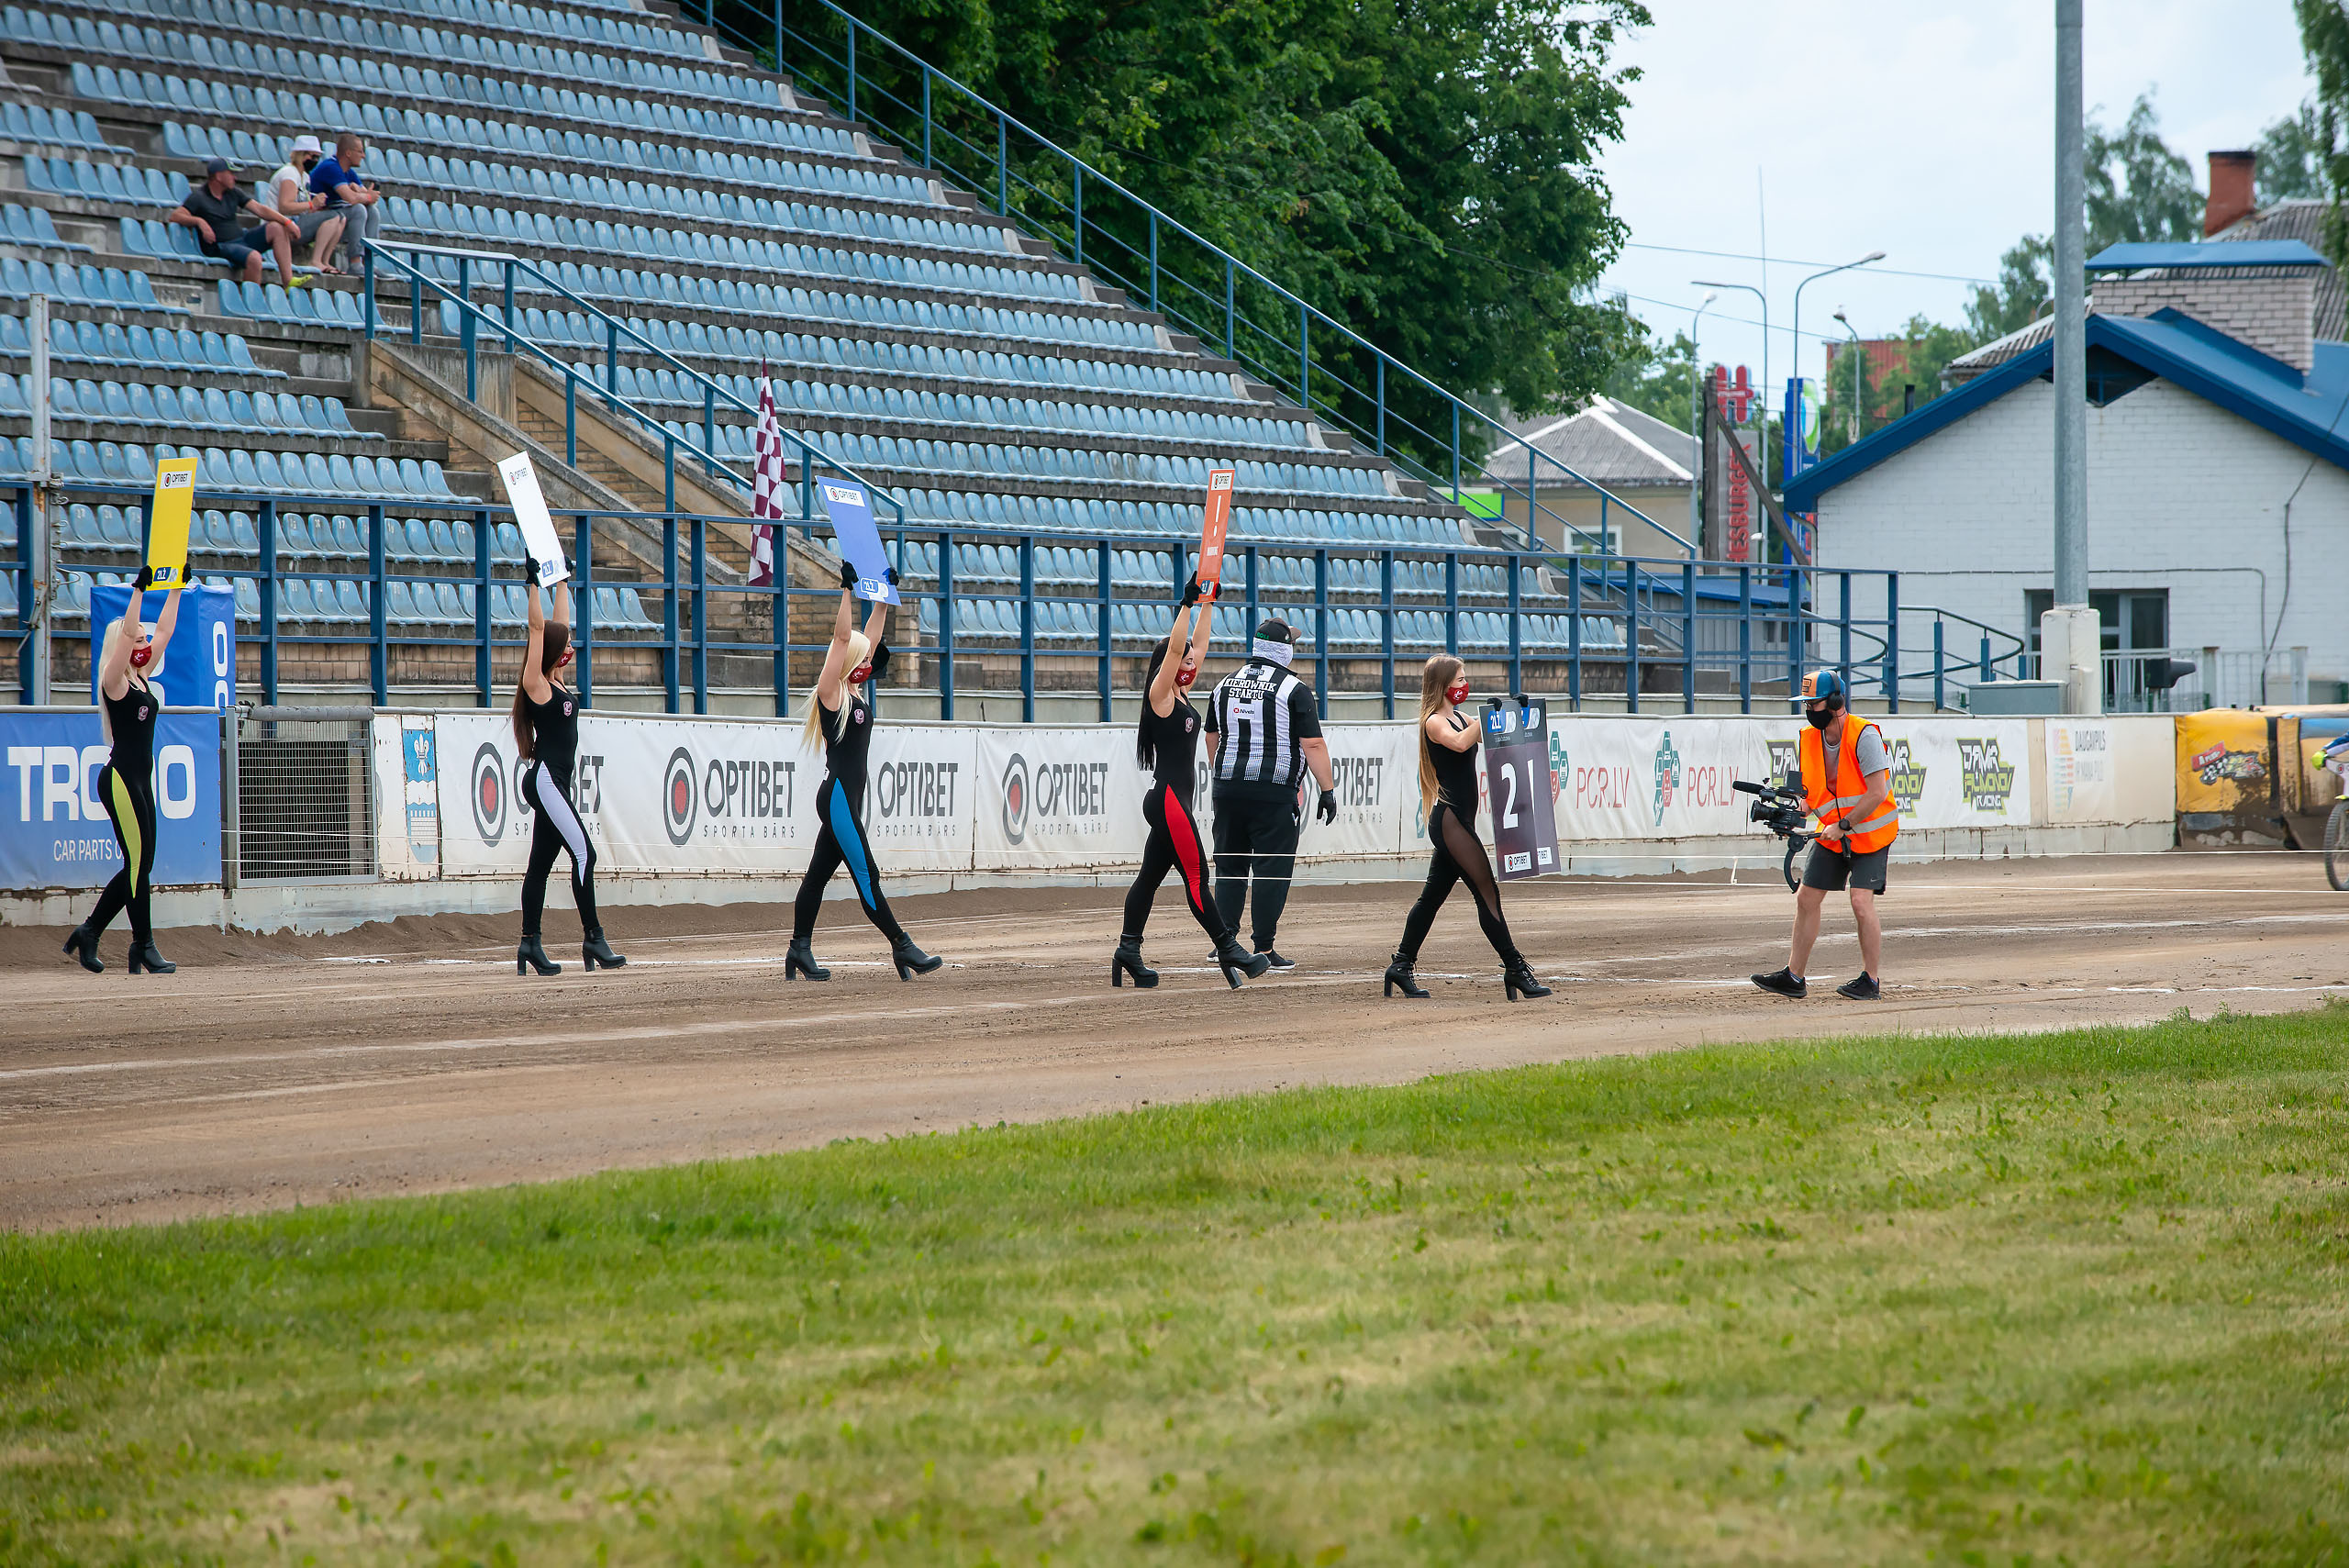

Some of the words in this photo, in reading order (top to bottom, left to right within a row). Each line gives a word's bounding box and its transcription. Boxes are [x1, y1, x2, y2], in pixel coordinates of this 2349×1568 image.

[172, 473, 188, 483] OPTIBET
[1224, 678, 1277, 693] KIEROWNIK
[1229, 688, 1264, 700] STARTU
[7, 745, 196, 821] TROO
[514, 755, 605, 816] OBET
[705, 759, 796, 818] OPTIBET
[878, 762, 958, 818] OPTIBET
[1036, 762, 1108, 817] OPTIBET
[1321, 757, 1383, 806] PTIBET
[1500, 762, 1519, 829] 2
[1576, 767, 1630, 809] PCR.LV
[1687, 766, 1739, 807] PCR.LV
[54, 840, 76, 862] CAR
[79, 839, 112, 861] PARTS
[704, 825, 754, 838] SPORTA
[876, 825, 920, 838] SPORTA
[1035, 824, 1077, 836] SPORTA
